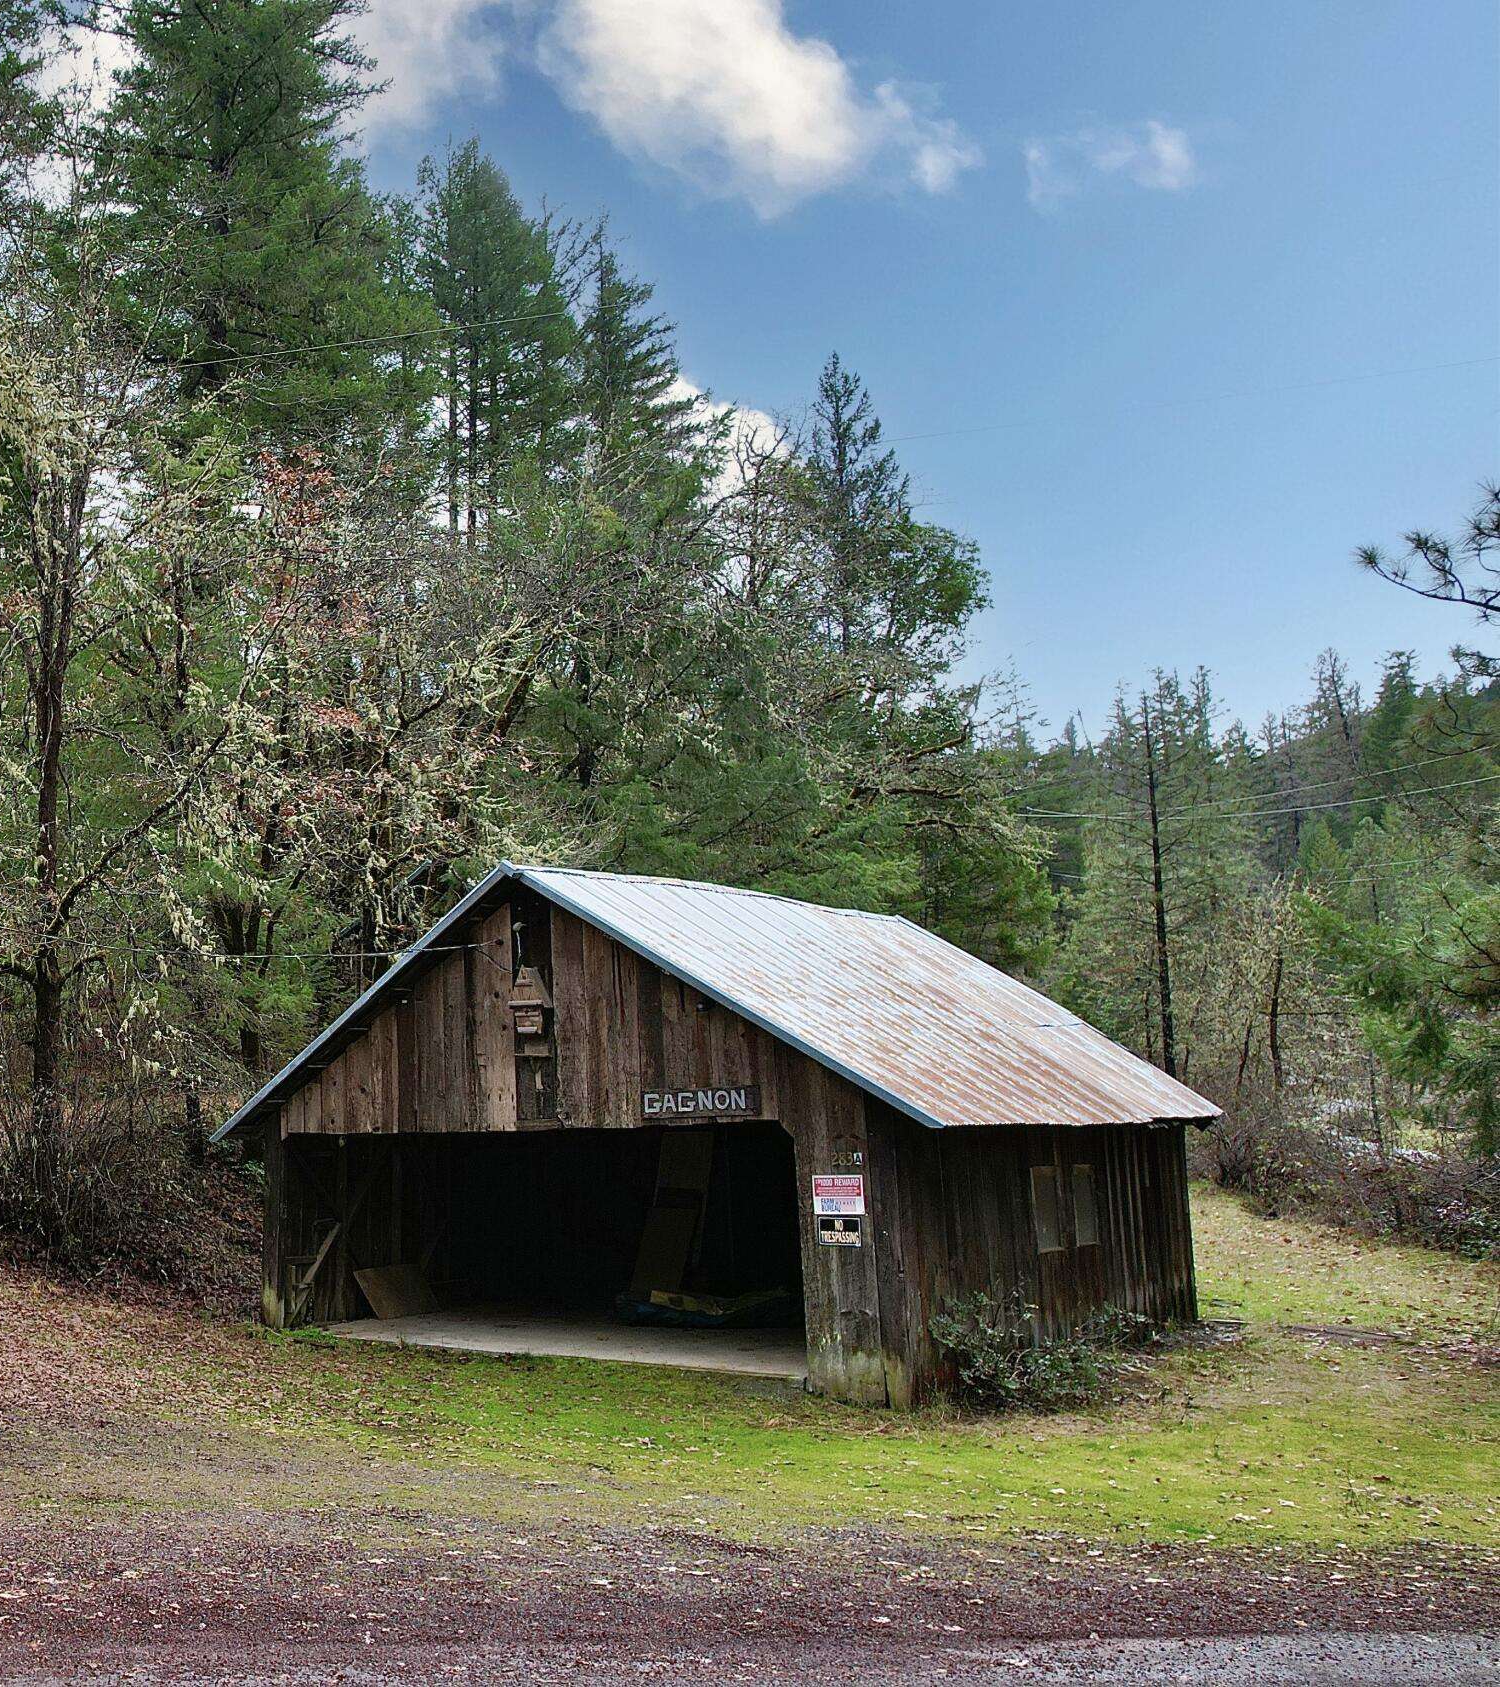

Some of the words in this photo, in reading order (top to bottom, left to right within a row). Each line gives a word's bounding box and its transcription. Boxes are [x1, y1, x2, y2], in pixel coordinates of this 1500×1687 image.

[644, 1089, 746, 1113] GAGNON
[834, 1178, 860, 1187] REWARD
[834, 1219, 844, 1231] NO
[820, 1230, 860, 1245] TRESPASSING
